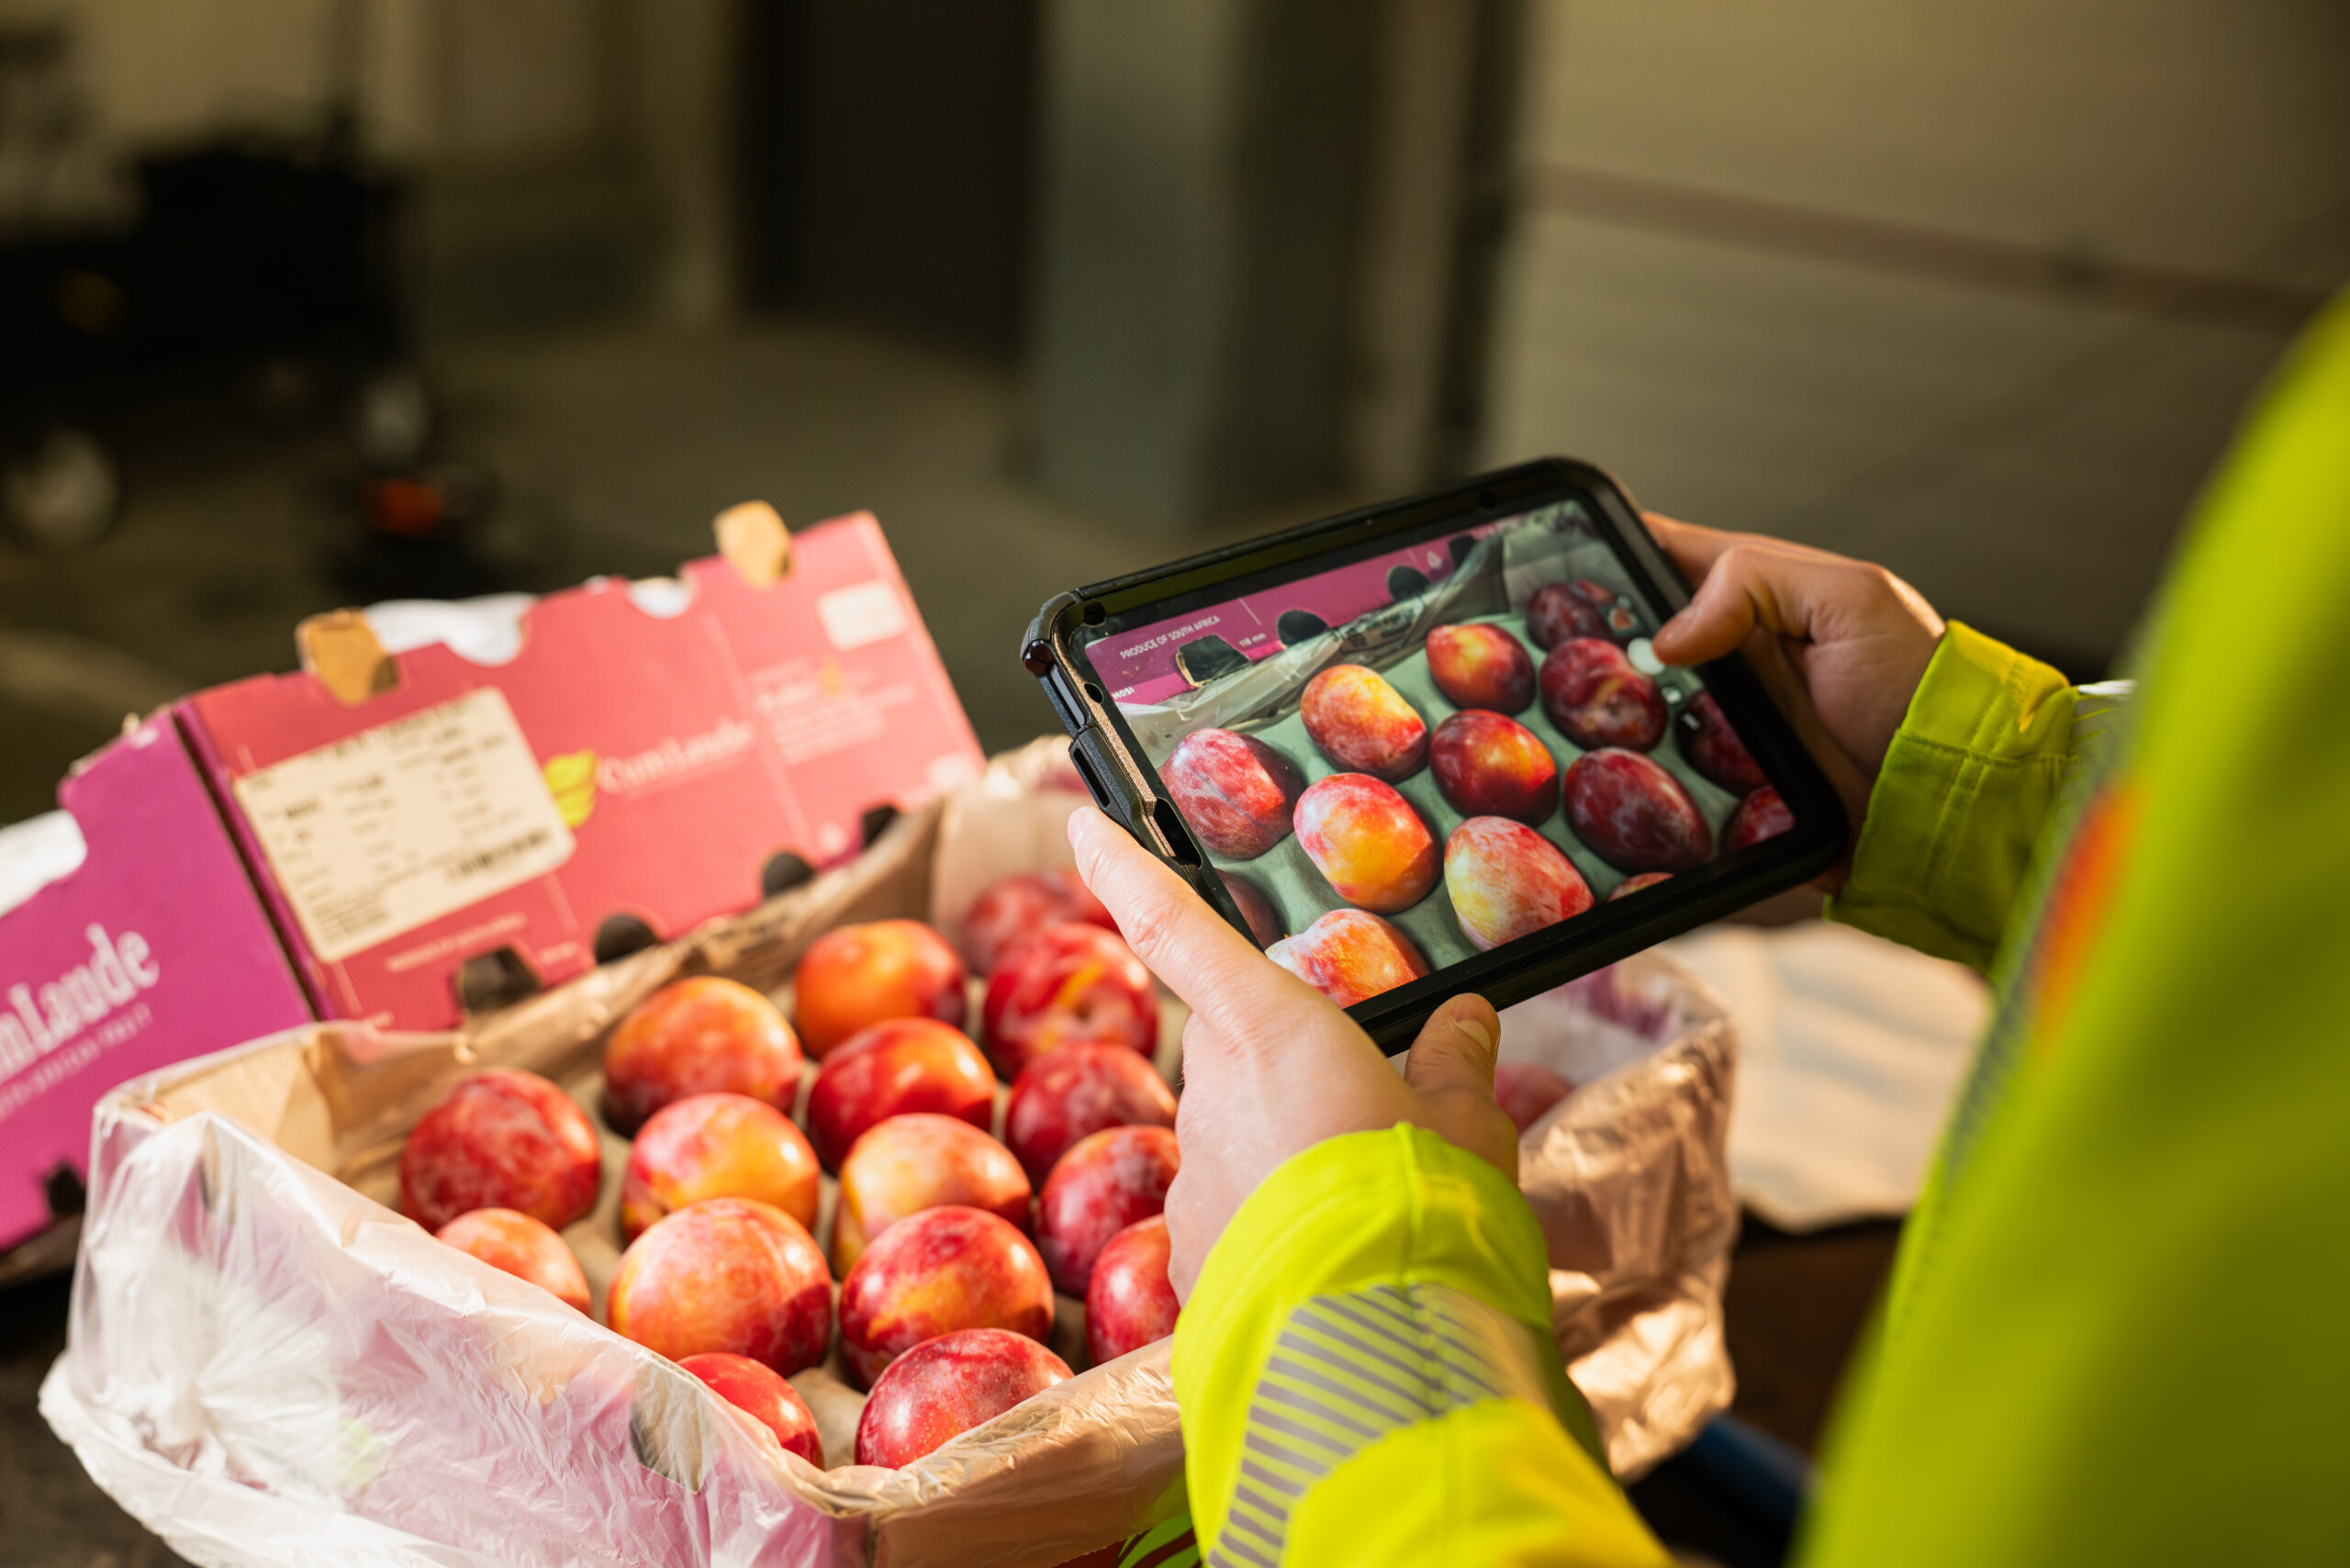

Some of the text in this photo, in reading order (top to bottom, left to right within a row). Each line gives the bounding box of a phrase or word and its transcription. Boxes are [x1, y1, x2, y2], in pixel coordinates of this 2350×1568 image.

[1120, 615, 1221, 659] PRODUCE OF SOUTH AFRICA
